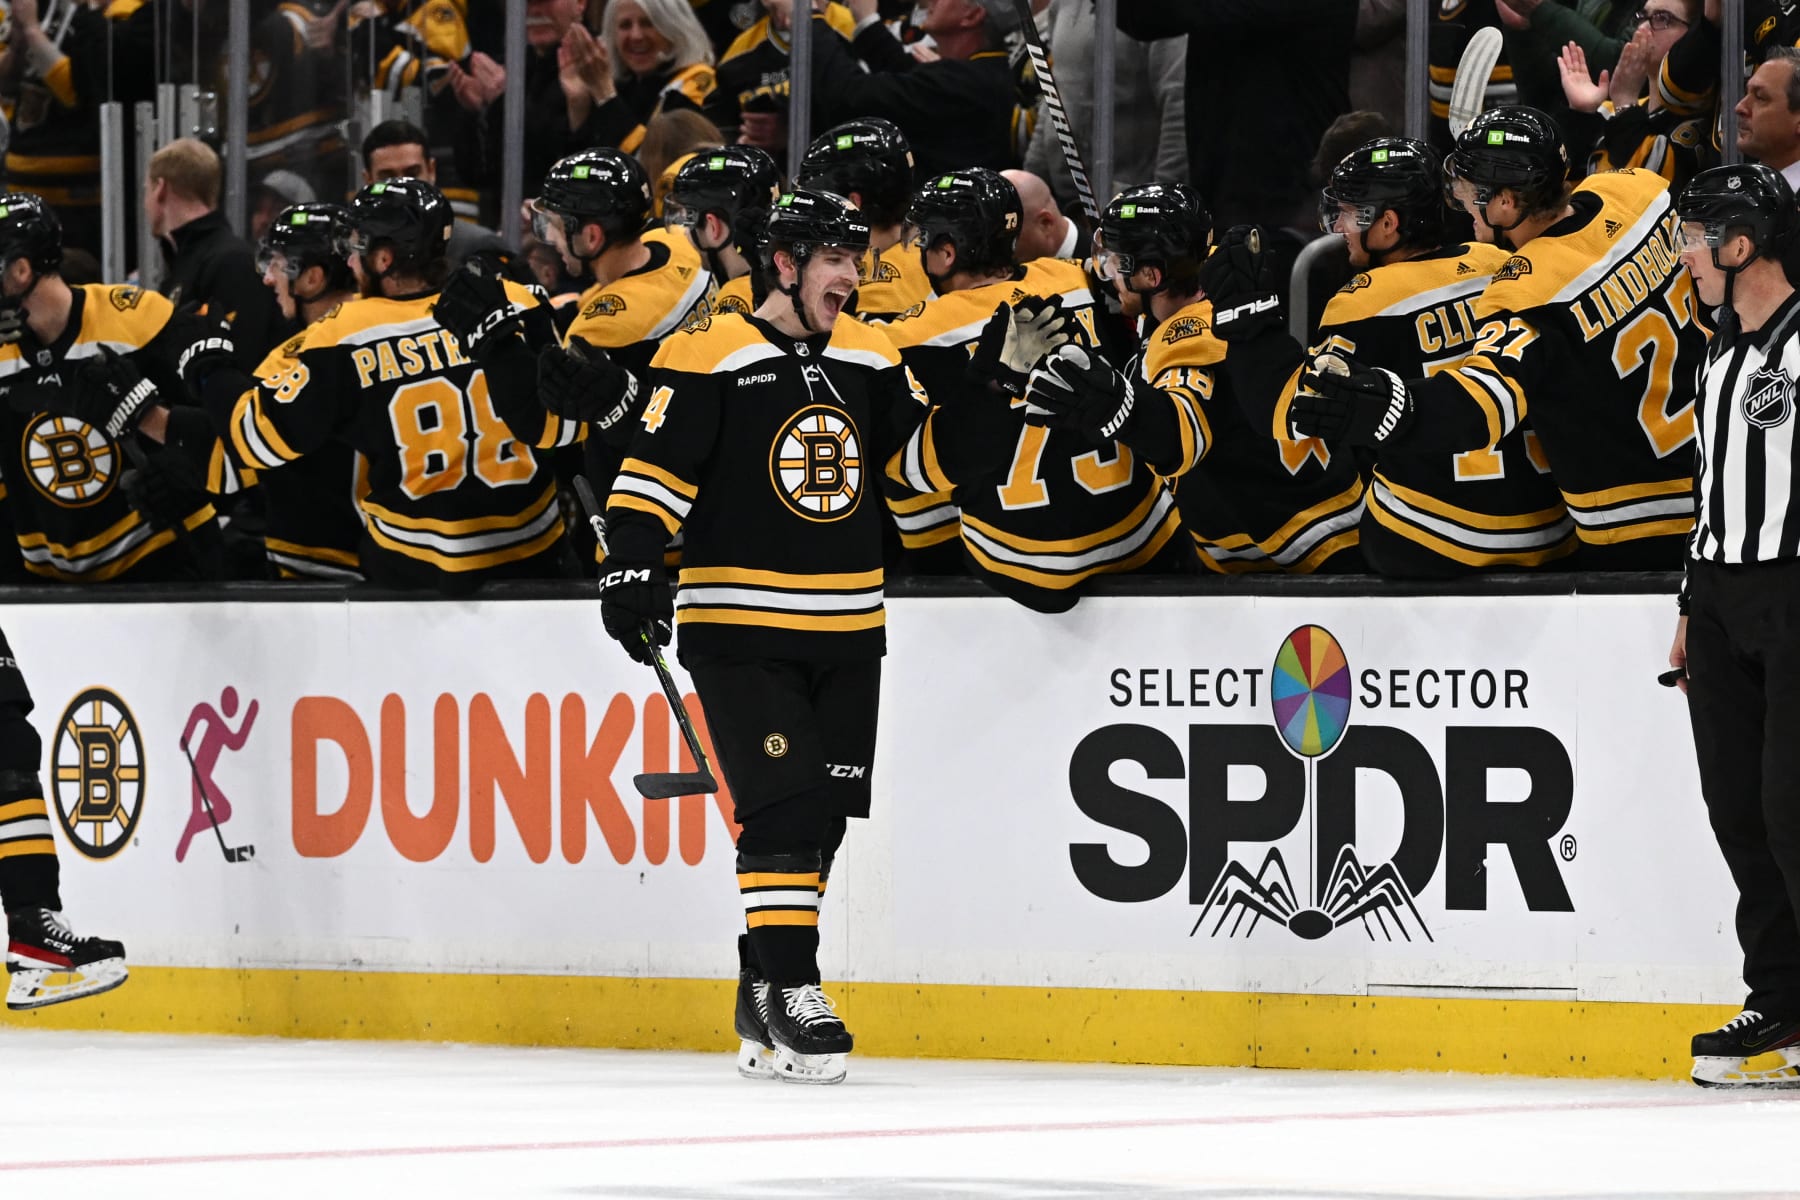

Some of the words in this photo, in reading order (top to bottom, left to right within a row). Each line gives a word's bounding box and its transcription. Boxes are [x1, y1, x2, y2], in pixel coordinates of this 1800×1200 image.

[1026, 43, 1100, 219] WARRIOR
[1505, 133, 1530, 143] Bank
[1389, 149, 1414, 158] Bank
[1137, 206, 1160, 214] Bank
[1473, 317, 1541, 362] 27
[641, 384, 675, 434] 4
[1751, 384, 1781, 414] NHL
[800, 431, 847, 496] B
[1109, 668, 1264, 708] SELECT
[1359, 669, 1530, 709] SECTOR
[76, 724, 120, 822] B
[826, 763, 866, 779] CM
